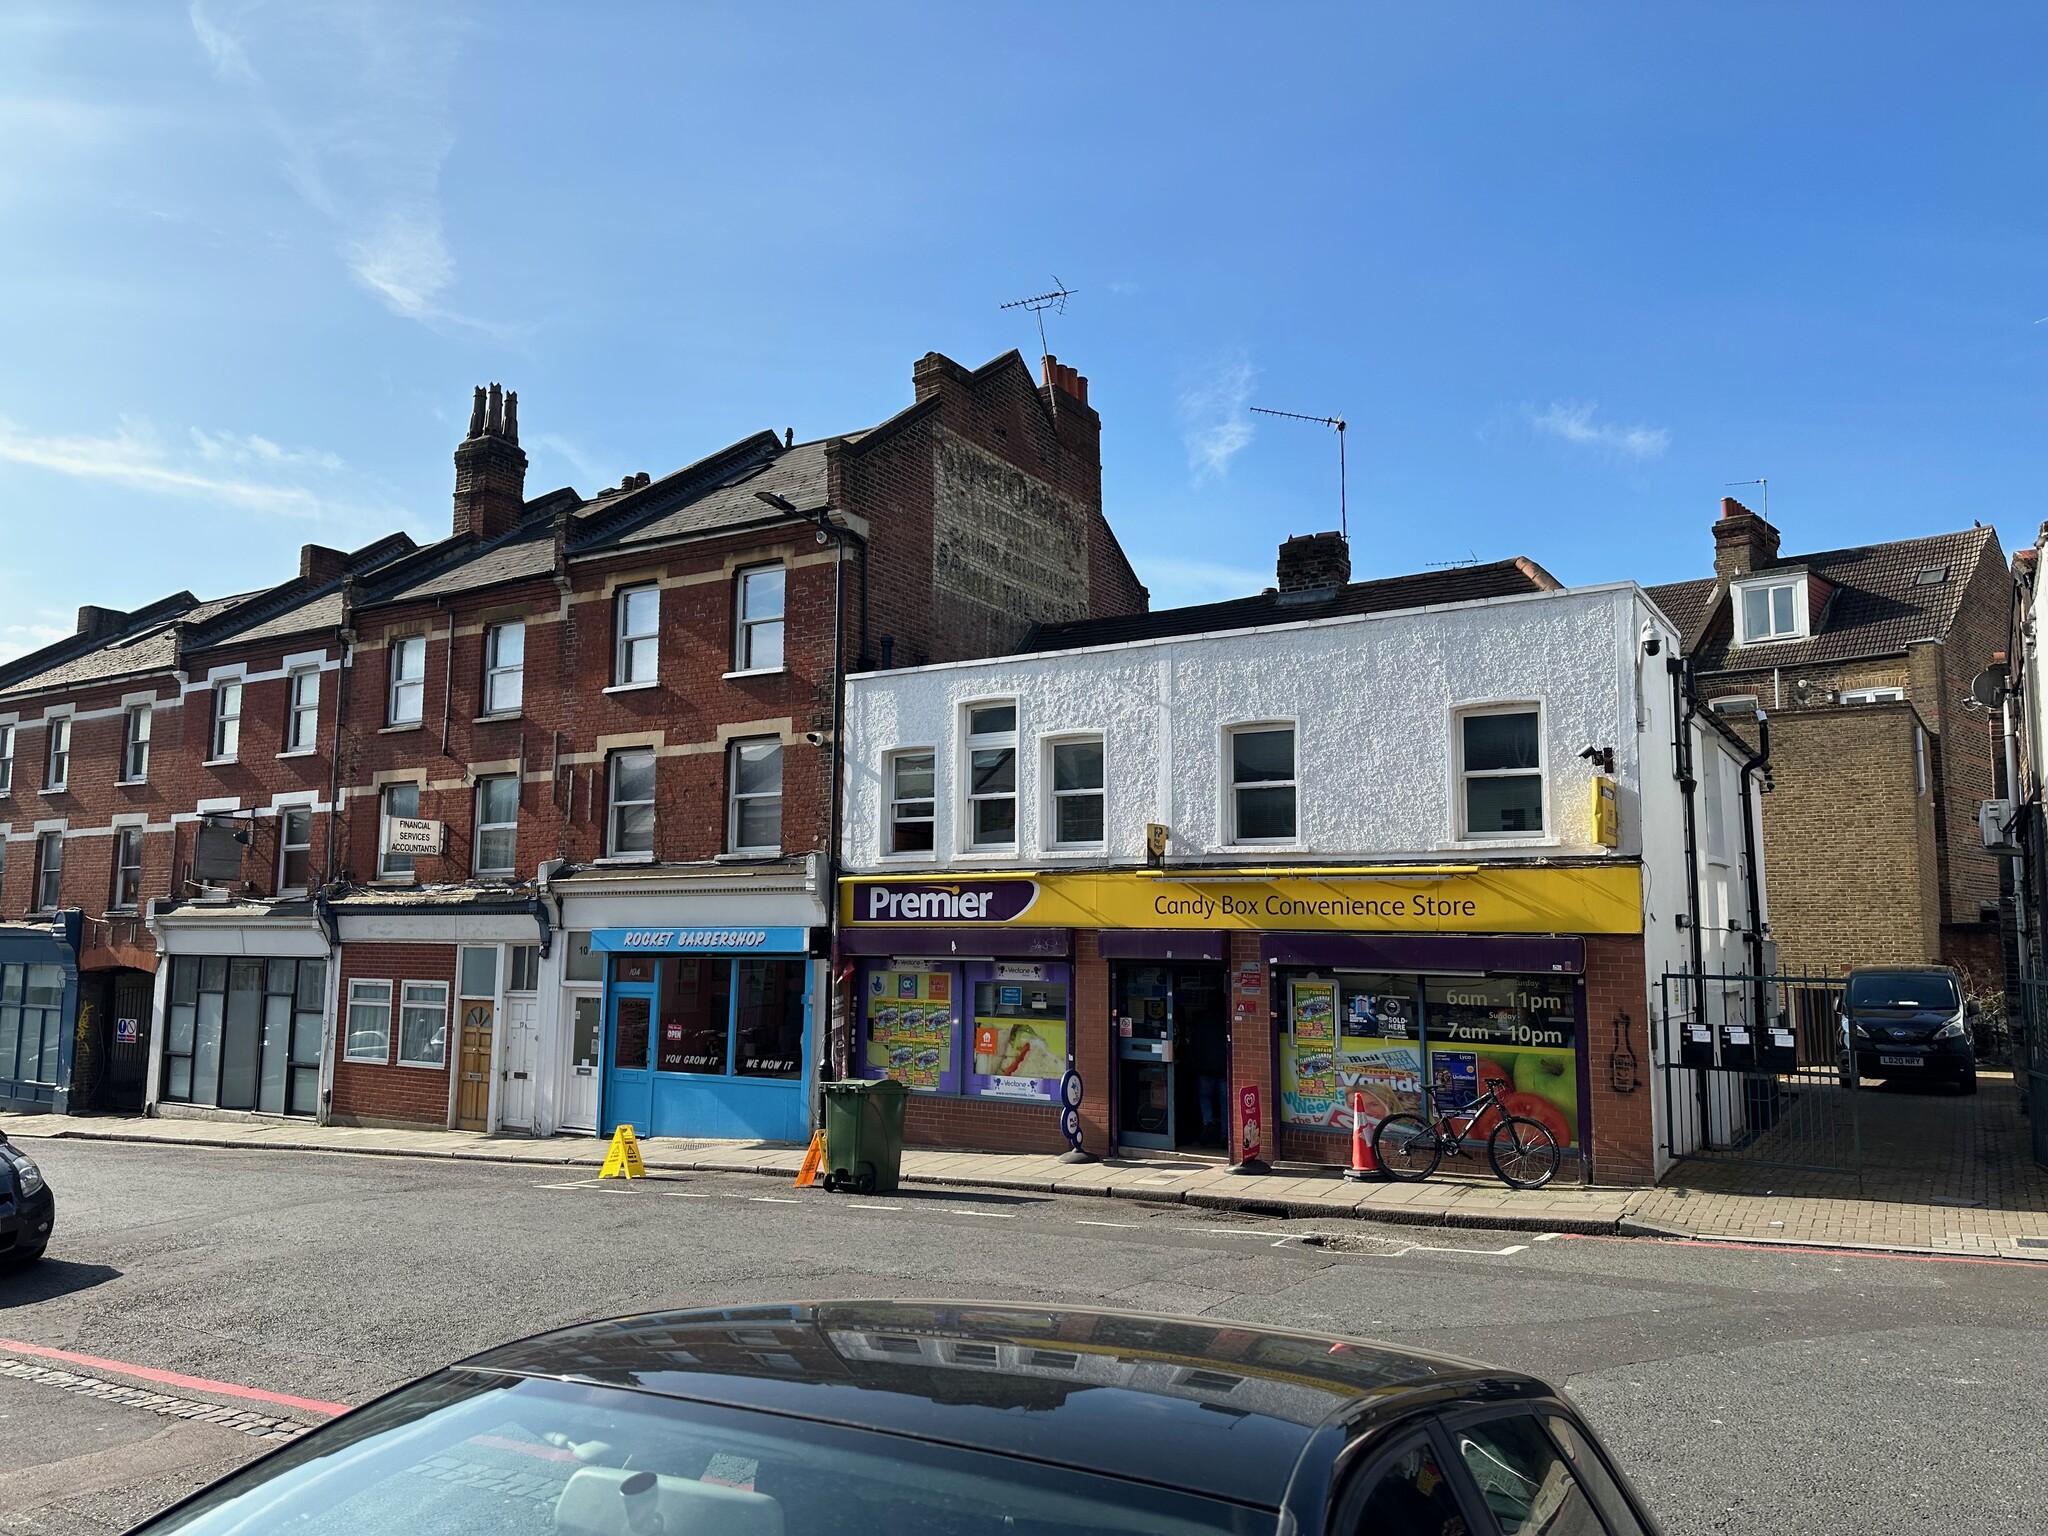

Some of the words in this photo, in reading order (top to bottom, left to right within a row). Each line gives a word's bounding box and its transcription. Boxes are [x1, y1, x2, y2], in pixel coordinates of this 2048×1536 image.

[400, 820, 431, 830] FINANCIAL
[400, 832, 431, 841] SERVICES
[391, 844, 437, 853] ACCOUNTANTS
[869, 885, 993, 918] Premier
[1154, 895, 1216, 919] Candy
[1221, 895, 1259, 915] Box
[1265, 895, 1405, 916] Convenience
[1412, 895, 1476, 916] Store
[624, 931, 675, 947] ROCKET
[678, 931, 767, 947] BARBERSHOP
[579, 946, 588, 955] 10
[629, 968, 641, 976] 10A
[1446, 989, 1488, 1006] 6am
[1506, 991, 1561, 1013] 11pm
[1488, 1011, 1517, 1021] Sunday
[667, 1030, 682, 1039] OPEN
[1447, 1022, 1489, 1040] 7am
[1507, 1025, 1562, 1047] 10pm
[665, 1054, 681, 1064] YOU
[683, 1055, 708, 1065] GROW
[708, 1056, 719, 1066] IT
[1347, 1053, 1381, 1064] Mail
[745, 1058, 758, 1068] WE
[761, 1059, 782, 1070] MOW
[783, 1061, 794, 1071] IT
[1364, 1068, 1405, 1076] Freeview
[1003, 1079, 1027, 1088] Vectone
[1290, 1116, 1311, 1125] The
